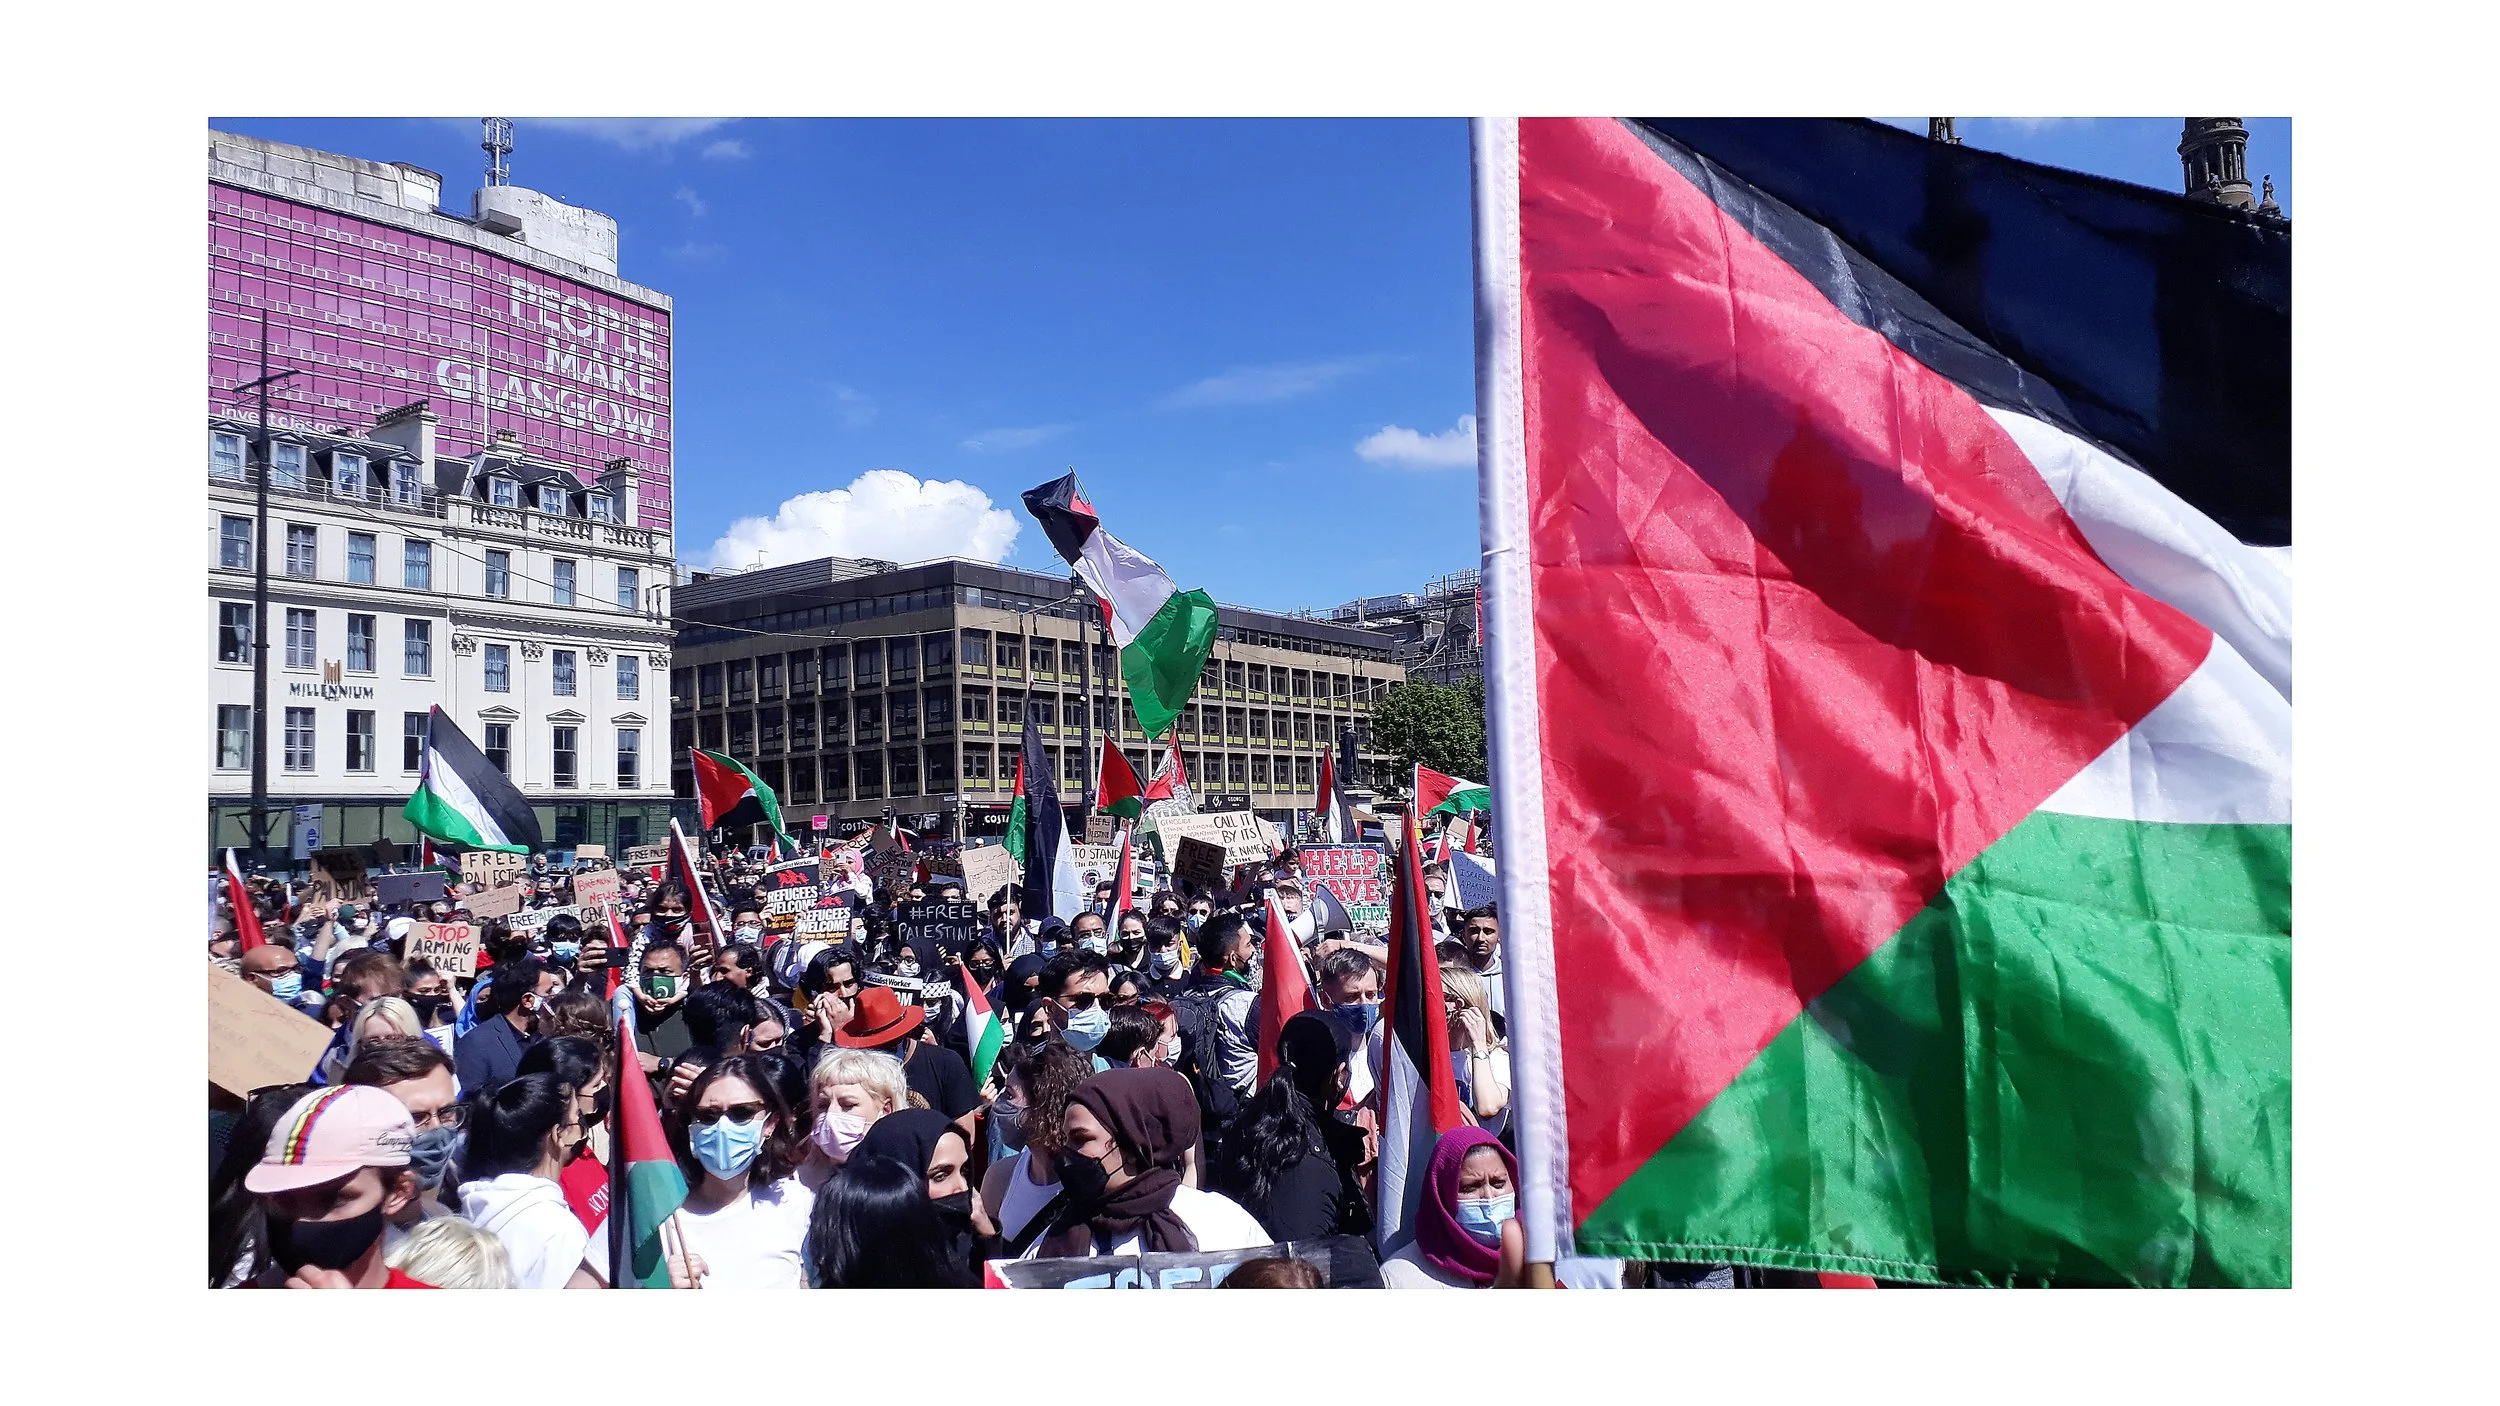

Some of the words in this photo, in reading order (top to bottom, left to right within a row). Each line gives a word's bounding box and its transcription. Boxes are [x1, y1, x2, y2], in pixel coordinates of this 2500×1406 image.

[511, 277, 658, 360] PEOPLE
[546, 336, 658, 404] MAKE
[437, 354, 656, 443] GLASGOW
[290, 682, 374, 700] MILLENNIUM
[1213, 814, 1238, 829] CALL
[1240, 813, 1251, 827] IT
[1222, 829, 1237, 844] BY
[1241, 827, 1257, 841] ITS
[468, 853, 517, 868] FREE
[1072, 847, 1086, 859] TO
[1090, 847, 1120, 860] STAND
[772, 861, 793, 871] Socialist
[793, 859, 812, 868] Worker
[1305, 849, 1379, 876] HELP
[882, 867, 894, 876] OF
[1460, 868, 1491, 883] ISRAELI
[767, 885, 818, 903] REFUGEES
[1460, 879, 1494, 895] APARTHEI
[589, 890, 618, 905] NEWS
[908, 904, 973, 920] #FREE
[1351, 907, 1386, 921] NITY
[510, 912, 535, 929] FREE
[796, 918, 850, 933] WELCOME
[425, 924, 471, 942] STOP
[801, 931, 816, 939] Open
[898, 922, 976, 941] PALESTINE
[411, 938, 472, 955] ARMING
[866, 974, 888, 985] Socialist
[889, 978, 912, 987] Worker
